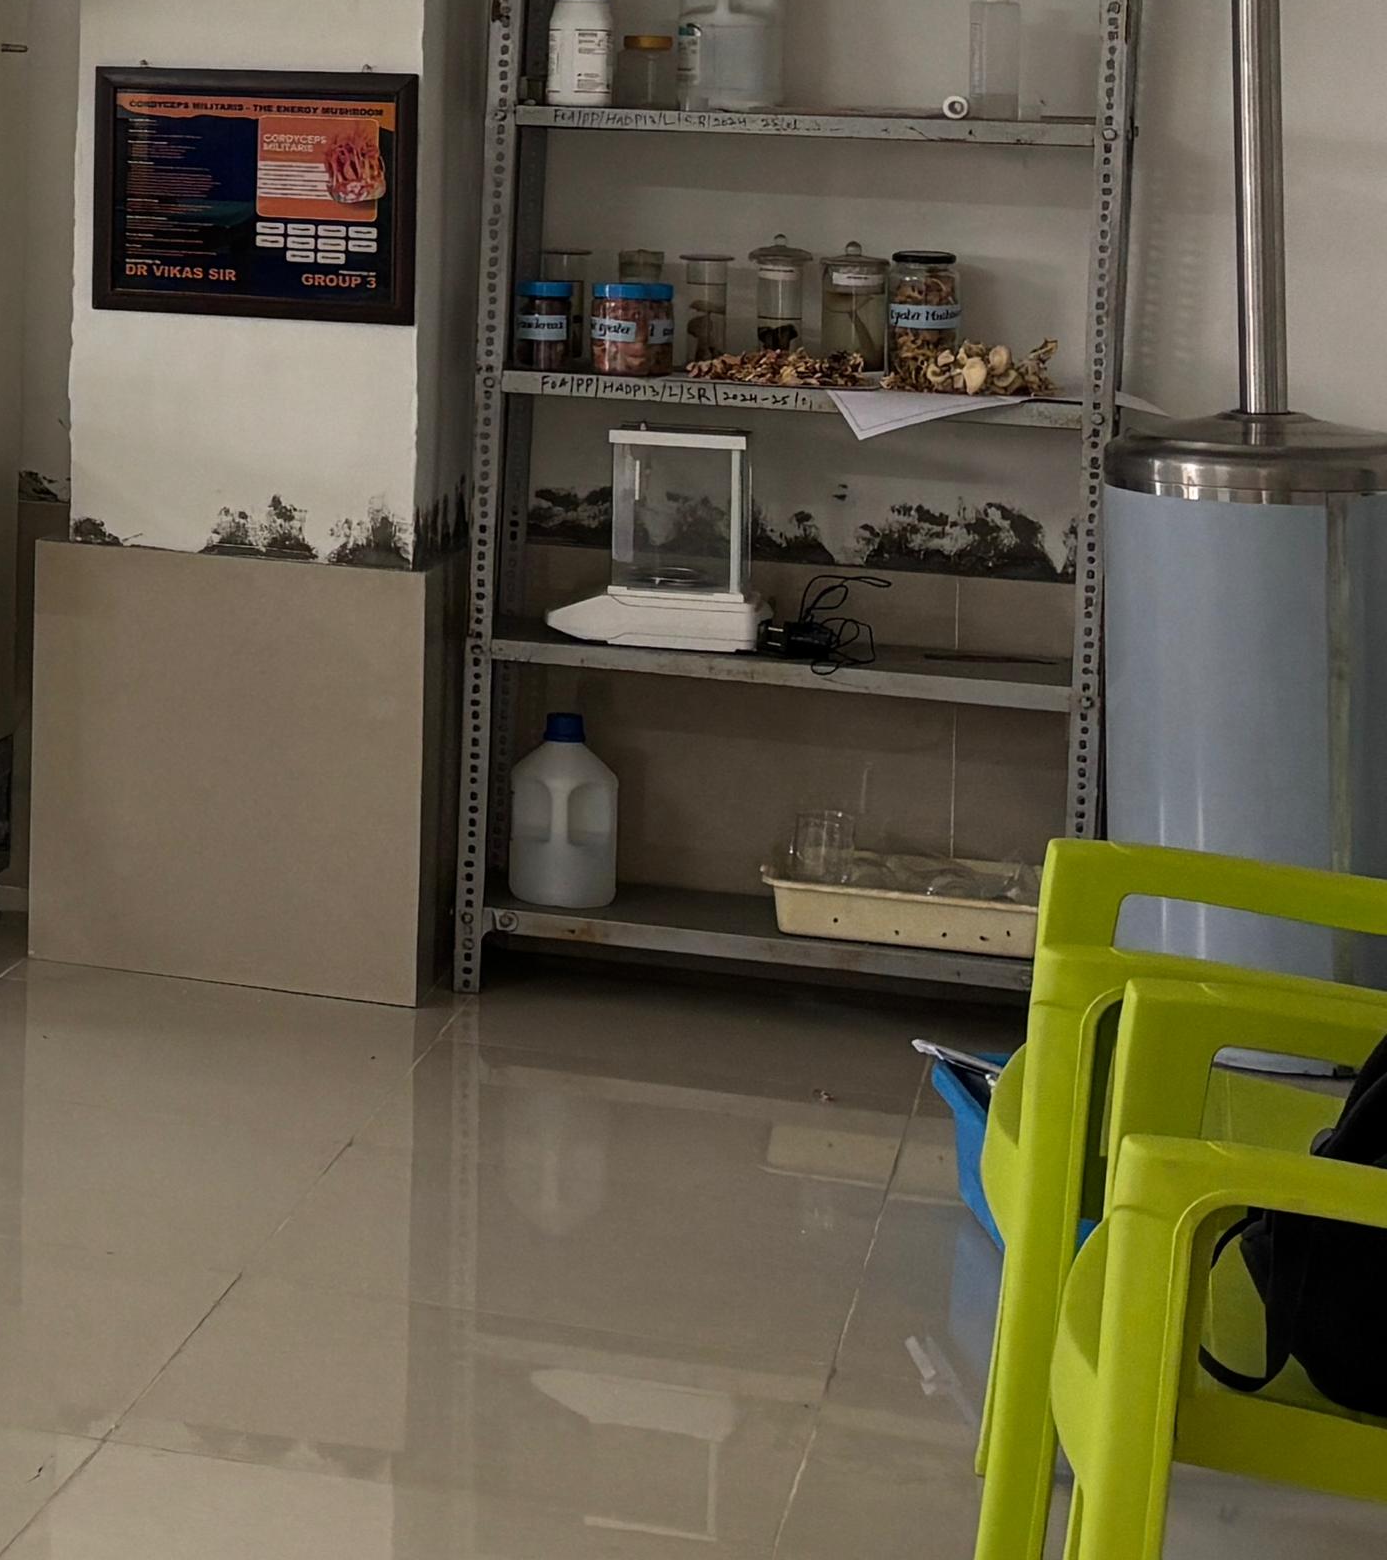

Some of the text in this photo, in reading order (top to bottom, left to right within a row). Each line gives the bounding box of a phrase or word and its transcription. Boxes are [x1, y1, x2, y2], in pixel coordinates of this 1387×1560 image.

[253, 104, 274, 113] THE
[276, 104, 319, 115] ENERGY
[263, 134, 327, 145] CORDYCEPS
[125, 263, 237, 281] DR VIKAS SIR
[301, 274, 377, 289] GROUP 3
